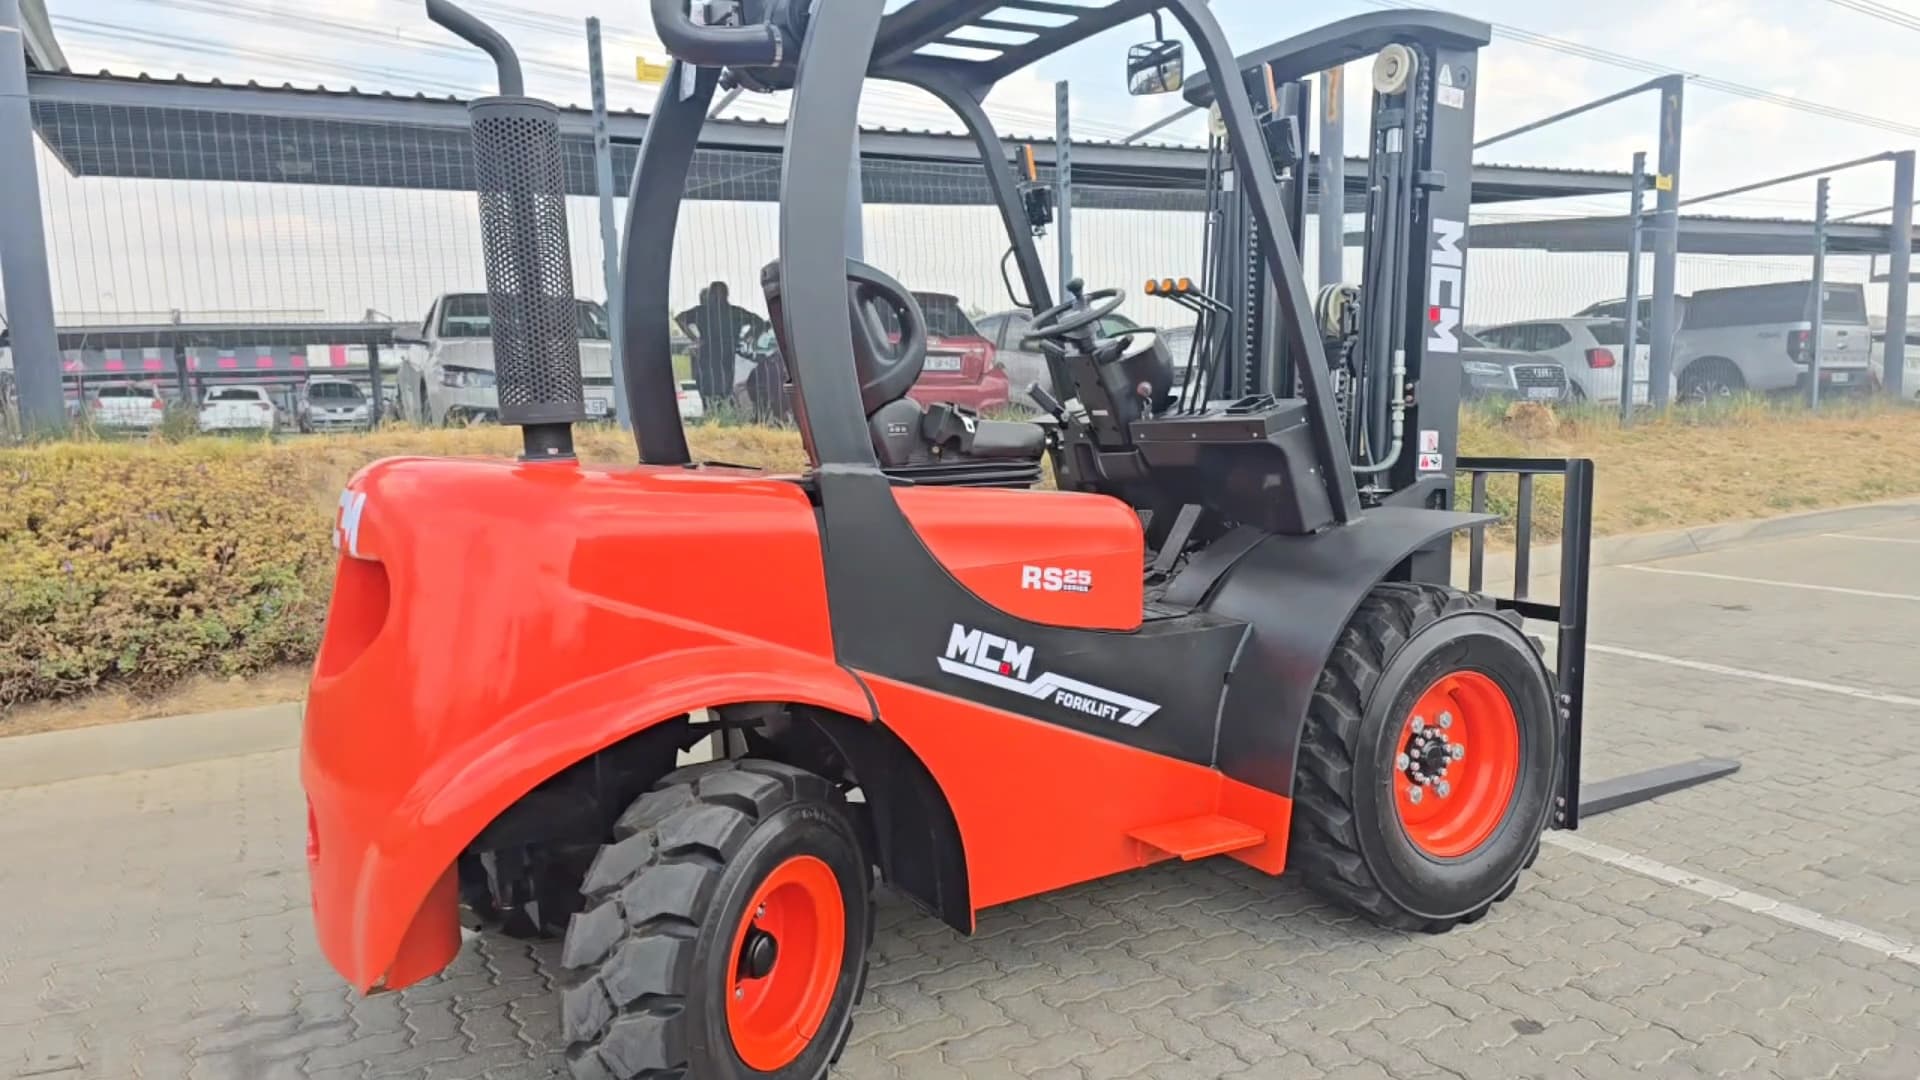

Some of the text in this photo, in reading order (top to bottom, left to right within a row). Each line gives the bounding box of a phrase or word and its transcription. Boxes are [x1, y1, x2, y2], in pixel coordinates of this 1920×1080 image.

[1427, 218, 1465, 353] MCM
[945, 623, 1035, 681] MCM
[1054, 690, 1120, 721] FORKLIFT
